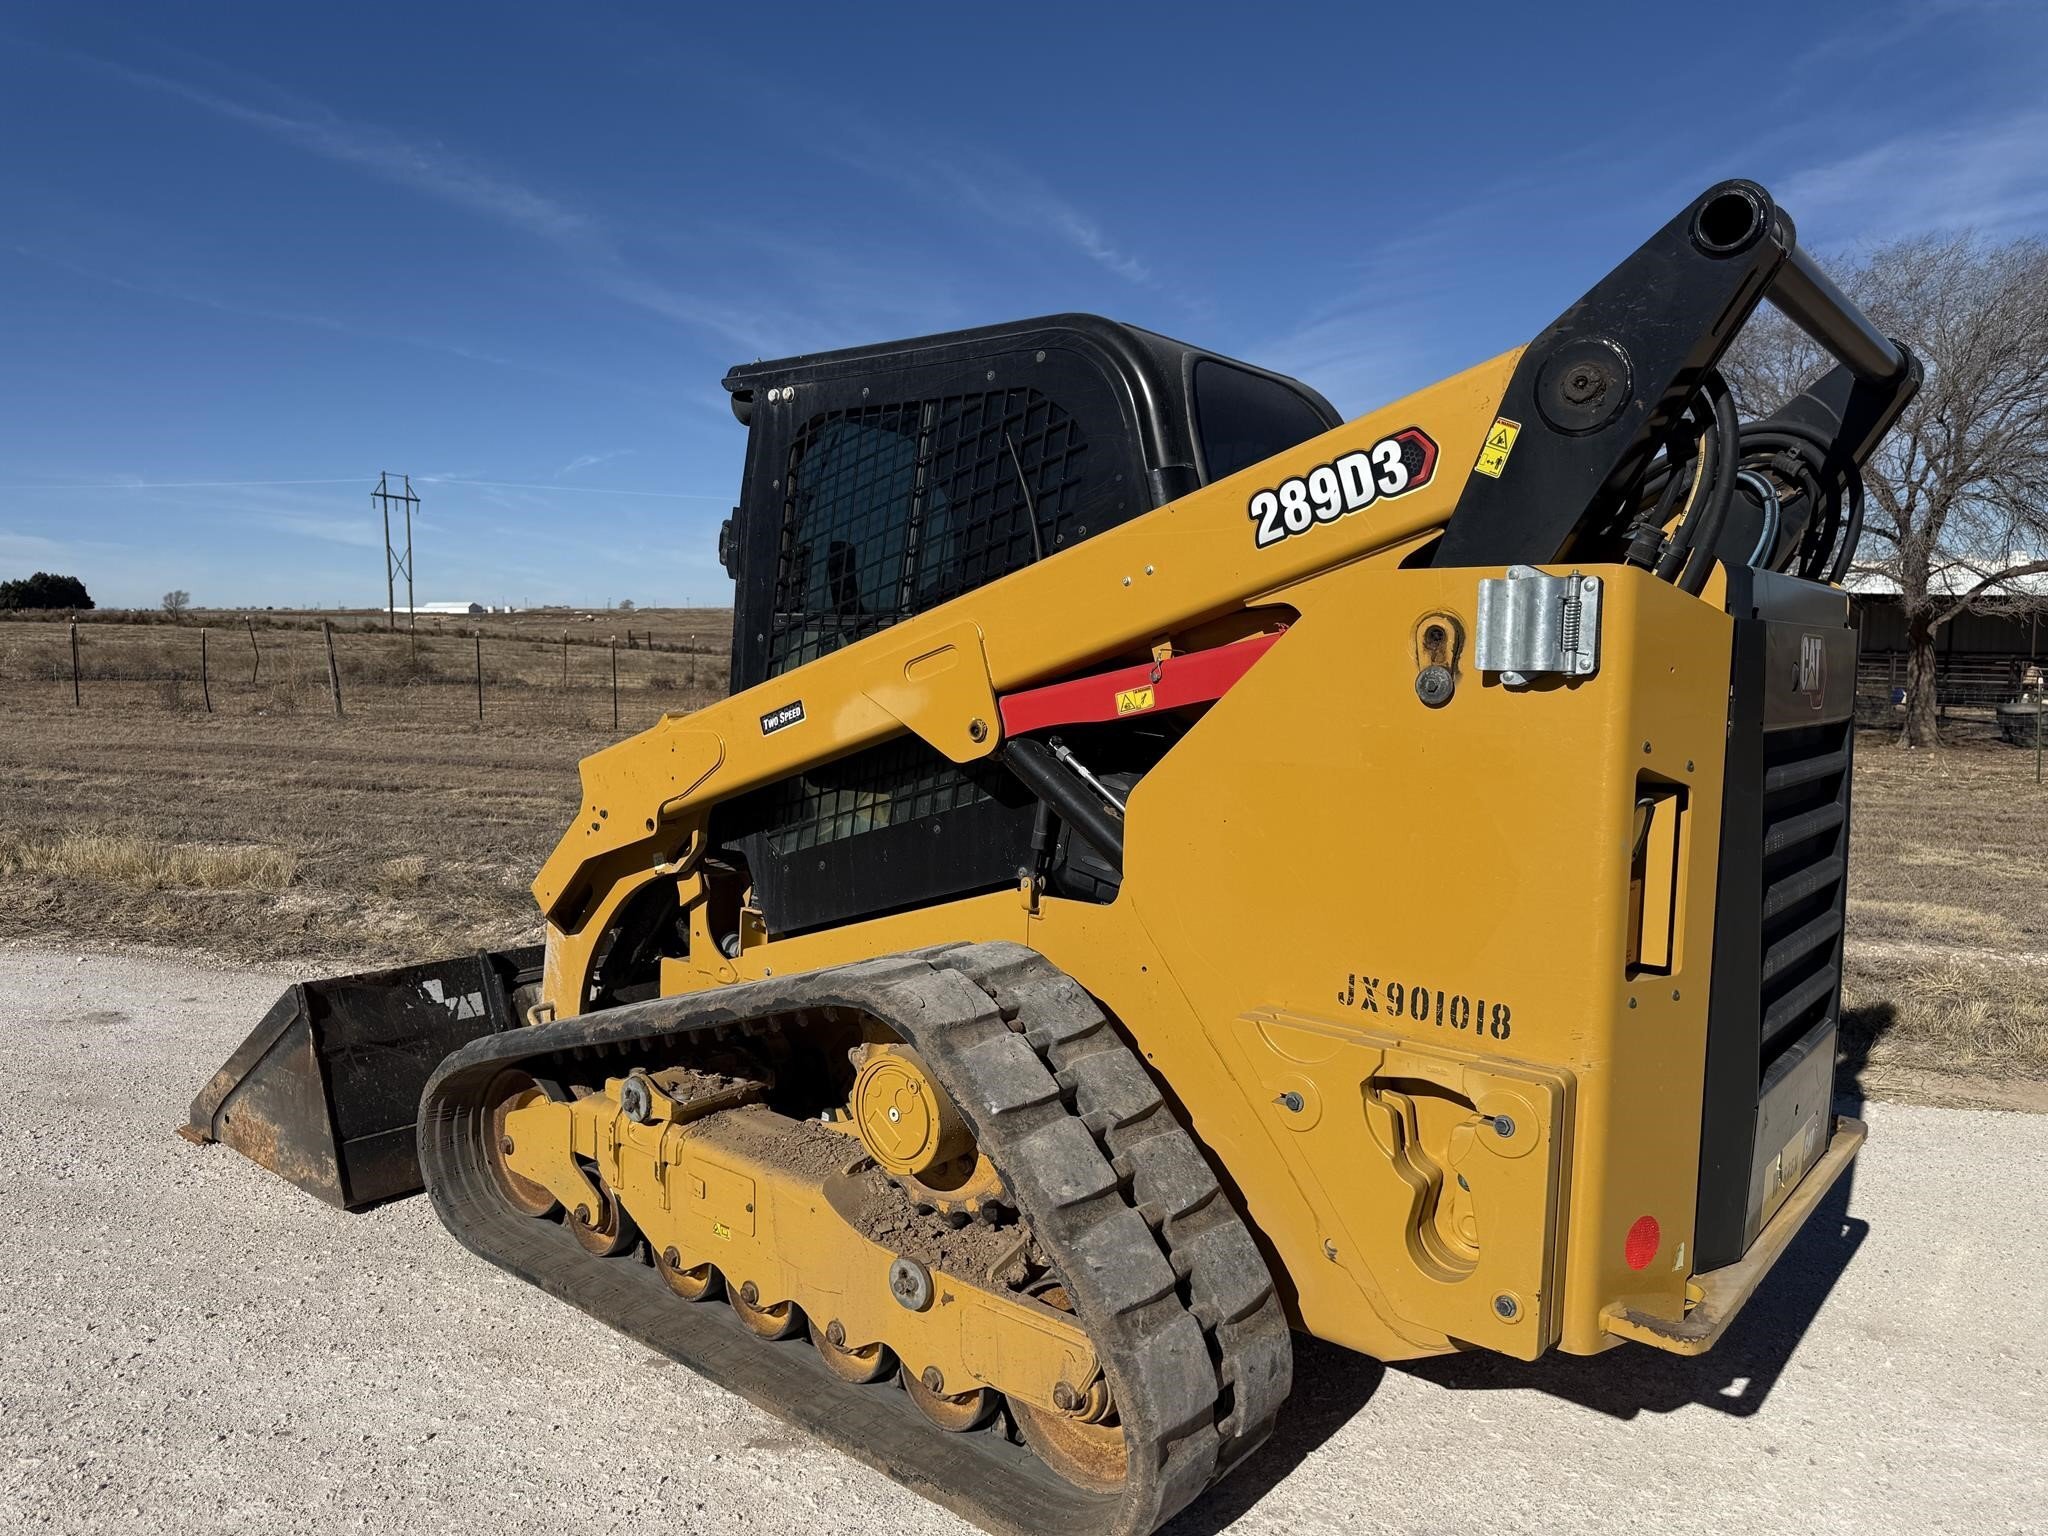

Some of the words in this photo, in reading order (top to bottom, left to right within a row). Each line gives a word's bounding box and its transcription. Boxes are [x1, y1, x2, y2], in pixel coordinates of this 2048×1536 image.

[1250, 439, 1409, 546] 289D3
[1802, 636, 1822, 690] CAT
[1337, 973, 1512, 1040] JX901018
